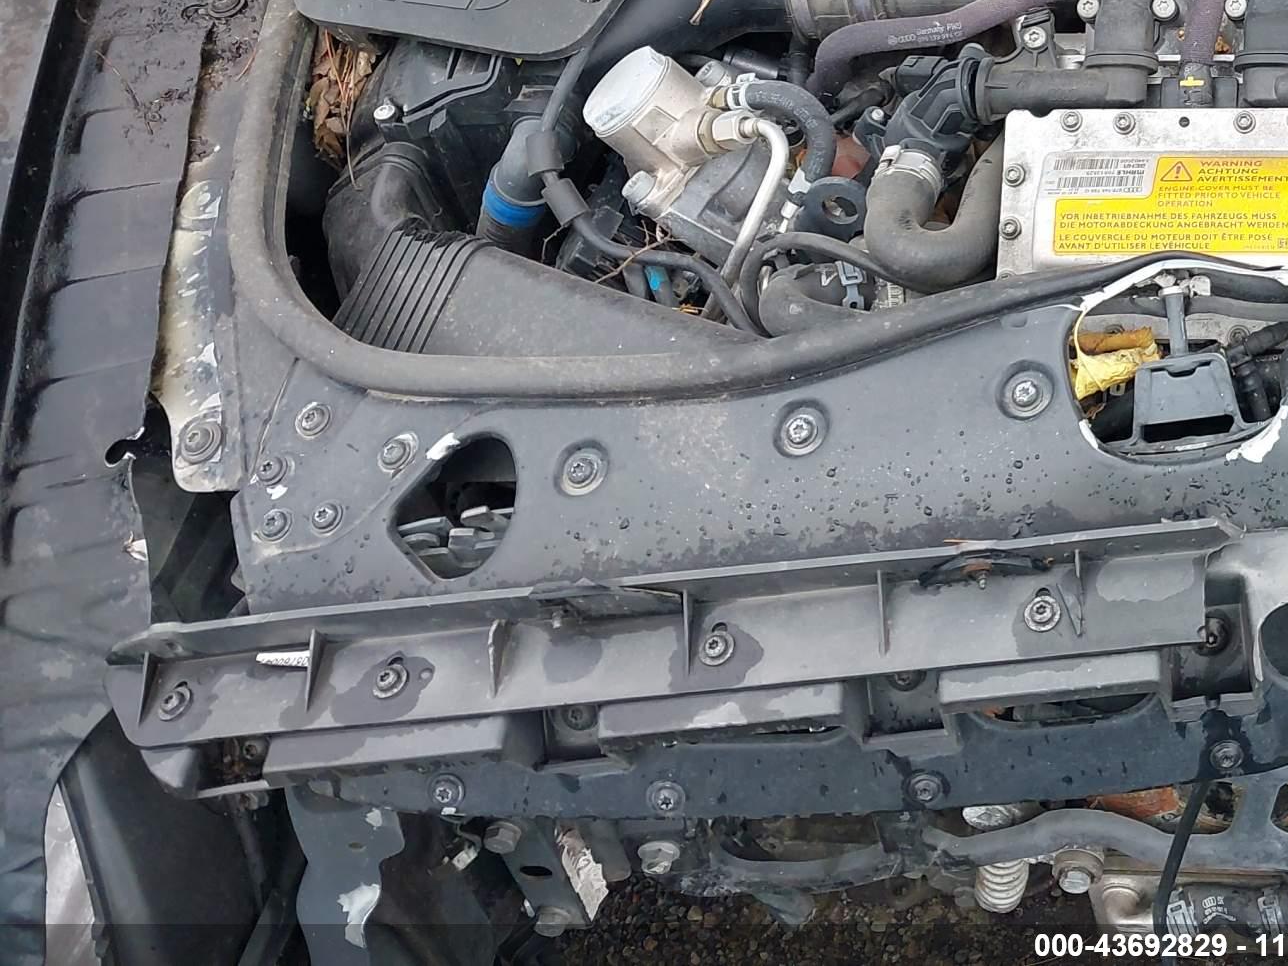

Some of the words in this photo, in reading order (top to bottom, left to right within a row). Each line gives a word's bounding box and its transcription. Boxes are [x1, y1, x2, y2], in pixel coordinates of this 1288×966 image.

[1221, 232, 1244, 241] ÊTRE
[1094, 242, 1147, 250] D'UTILISER
[1162, 241, 1210, 250] VÉHICULE
